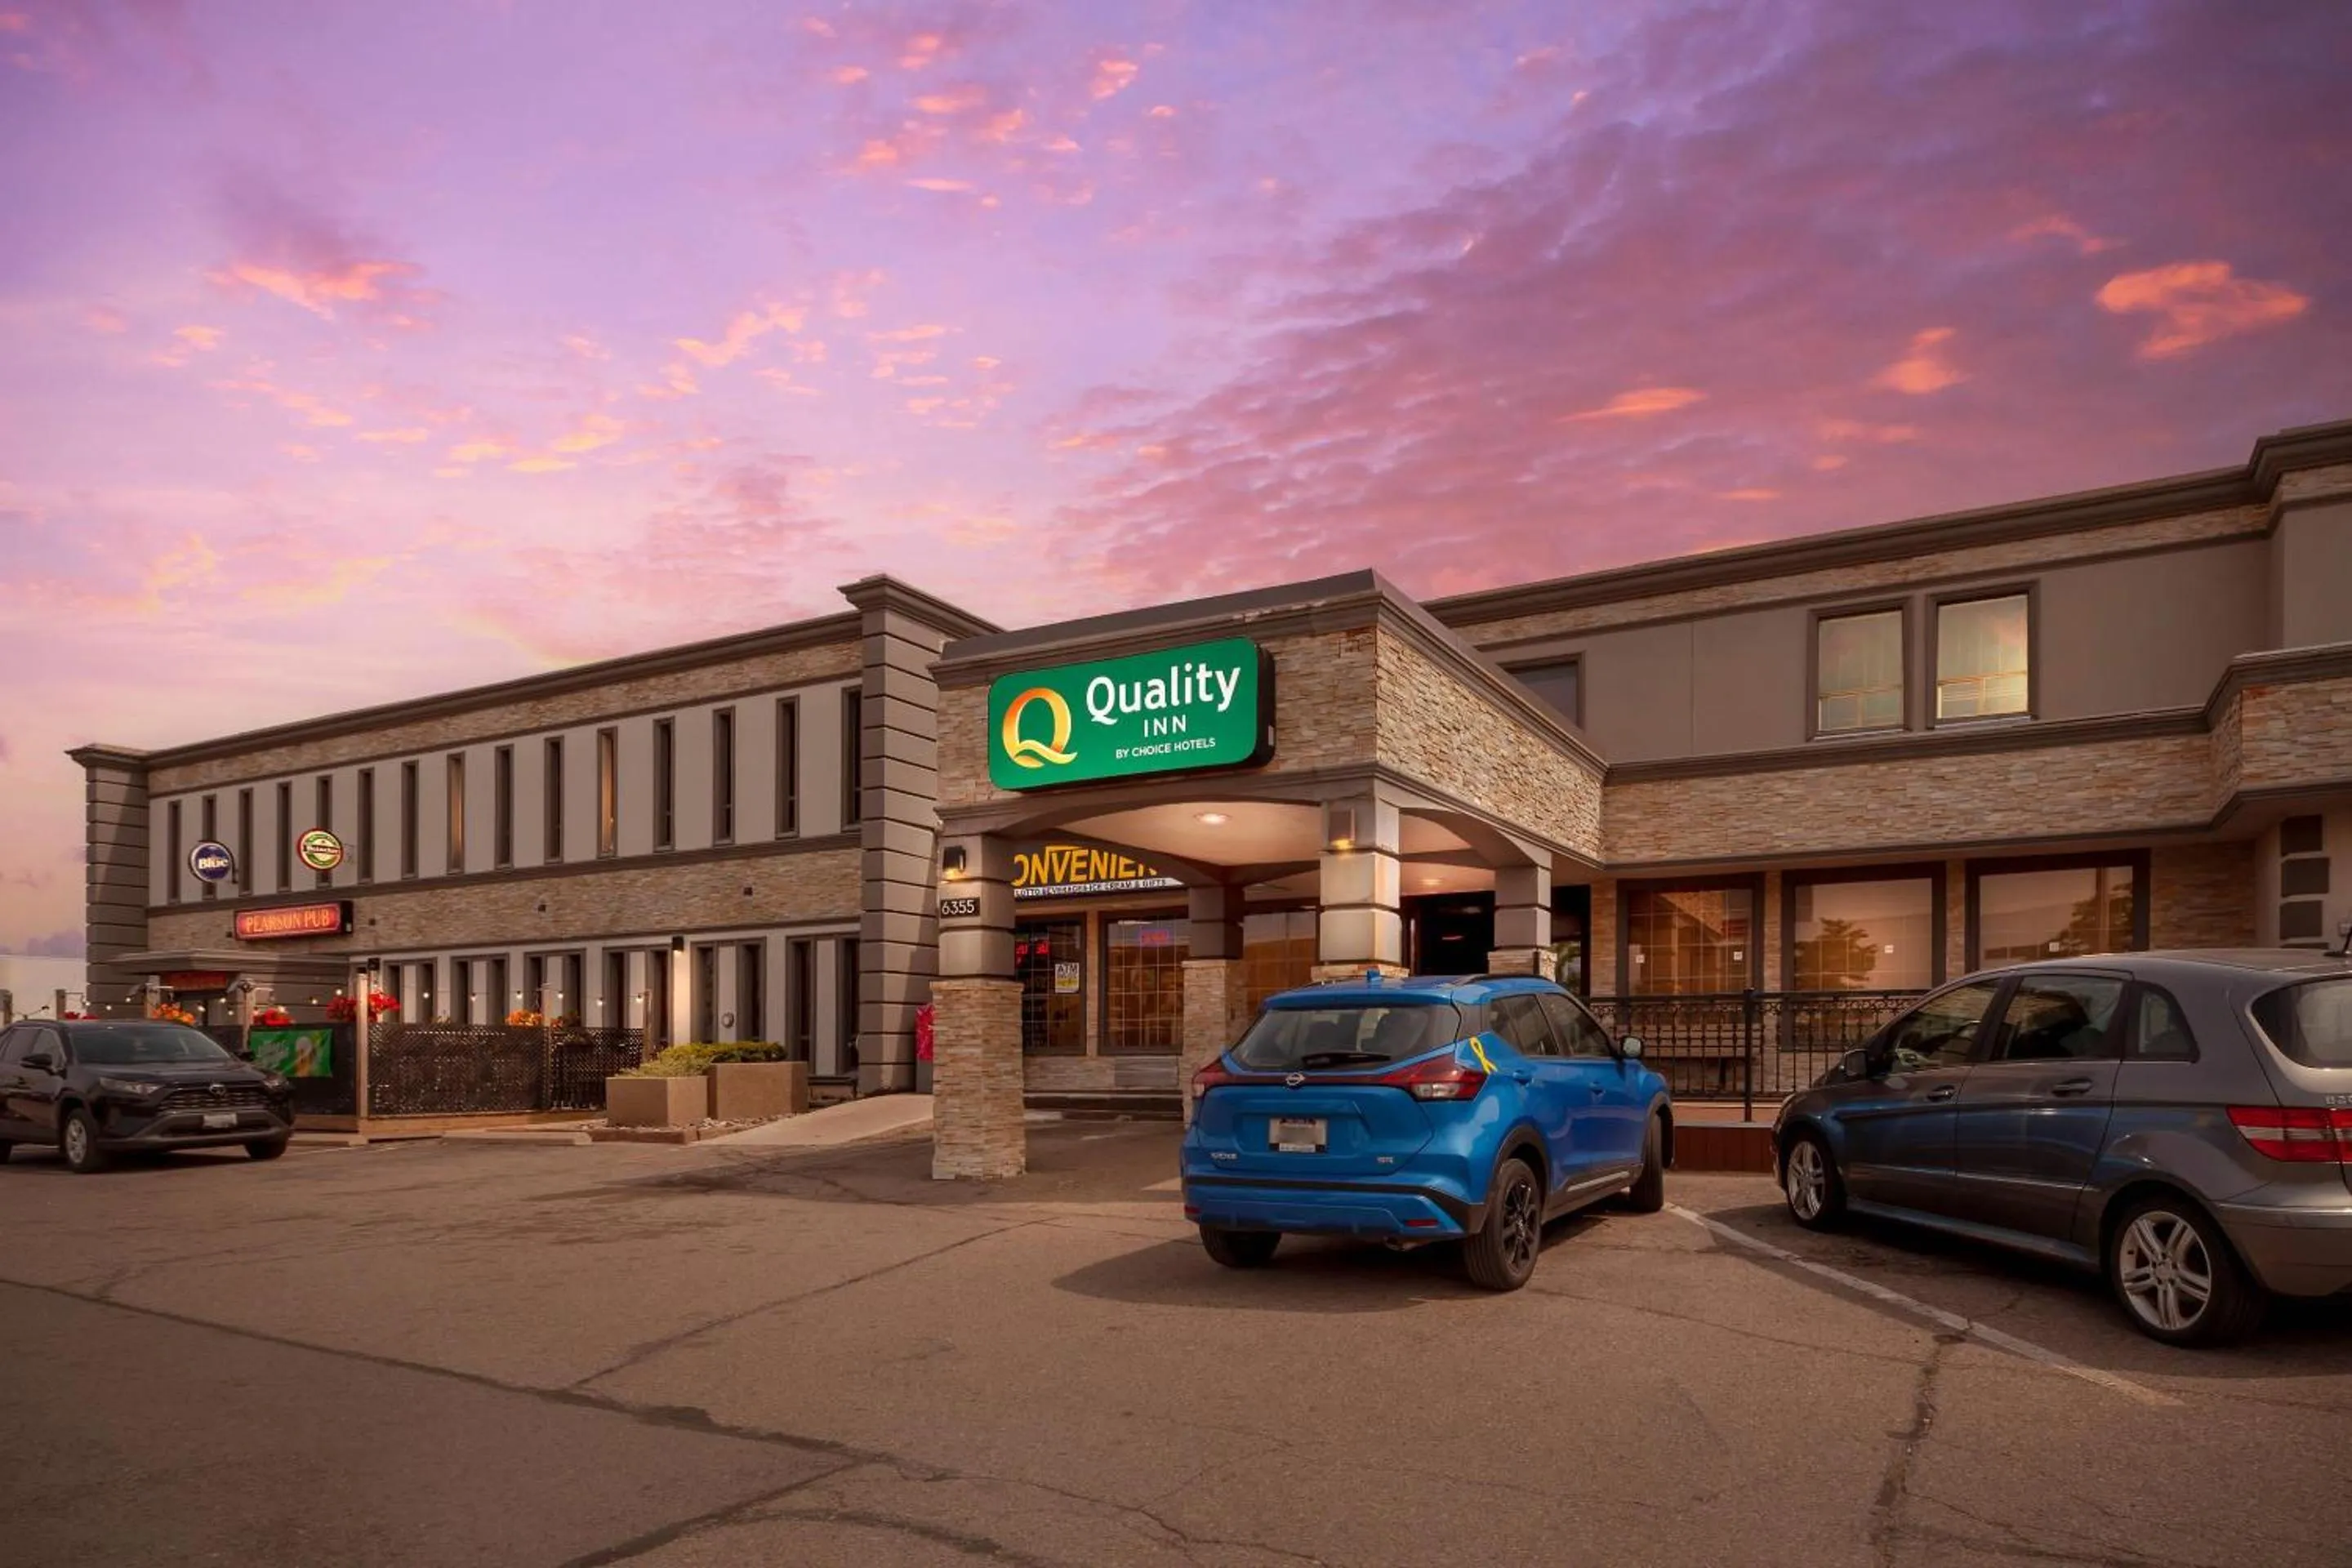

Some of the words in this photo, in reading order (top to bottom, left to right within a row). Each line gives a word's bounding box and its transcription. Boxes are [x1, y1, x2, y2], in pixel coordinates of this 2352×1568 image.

[1086, 662, 1241, 725] Quality
[1003, 688, 1077, 768] Q
[1144, 715, 1187, 737] INN
[1116, 748, 1129, 759] BY
[1132, 743, 1172, 757] CHOICE
[1174, 737, 1216, 751] HOTELS
[198, 858, 229, 869] Blue
[942, 899, 975, 915] 6355
[246, 911, 301, 933] PEARSON
[304, 907, 330, 928] PUB
[1058, 964, 1077, 974] ATM
